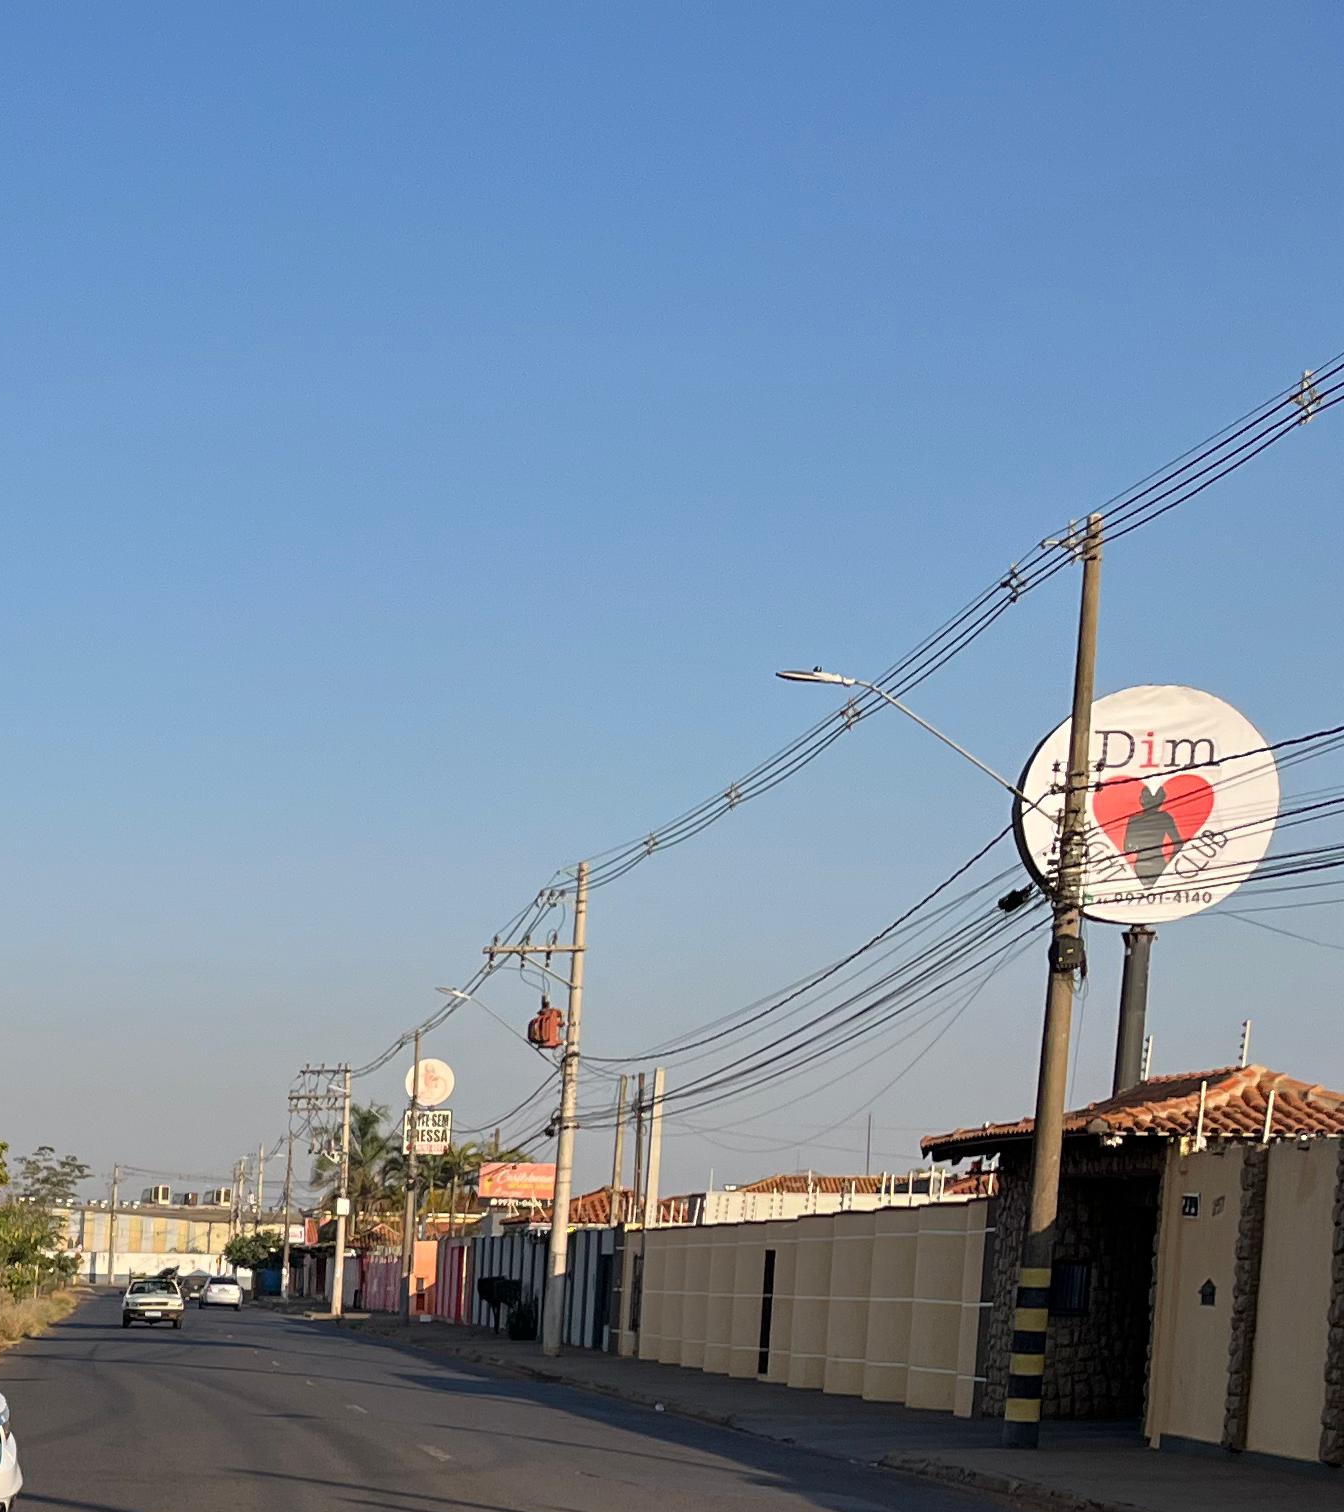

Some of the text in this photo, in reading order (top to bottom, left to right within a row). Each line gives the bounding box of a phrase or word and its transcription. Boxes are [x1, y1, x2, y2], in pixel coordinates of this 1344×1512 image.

[1093, 730, 1219, 768] Dim
[1175, 830, 1227, 878] CLUB
[407, 1113, 449, 1127] NITE SEM
